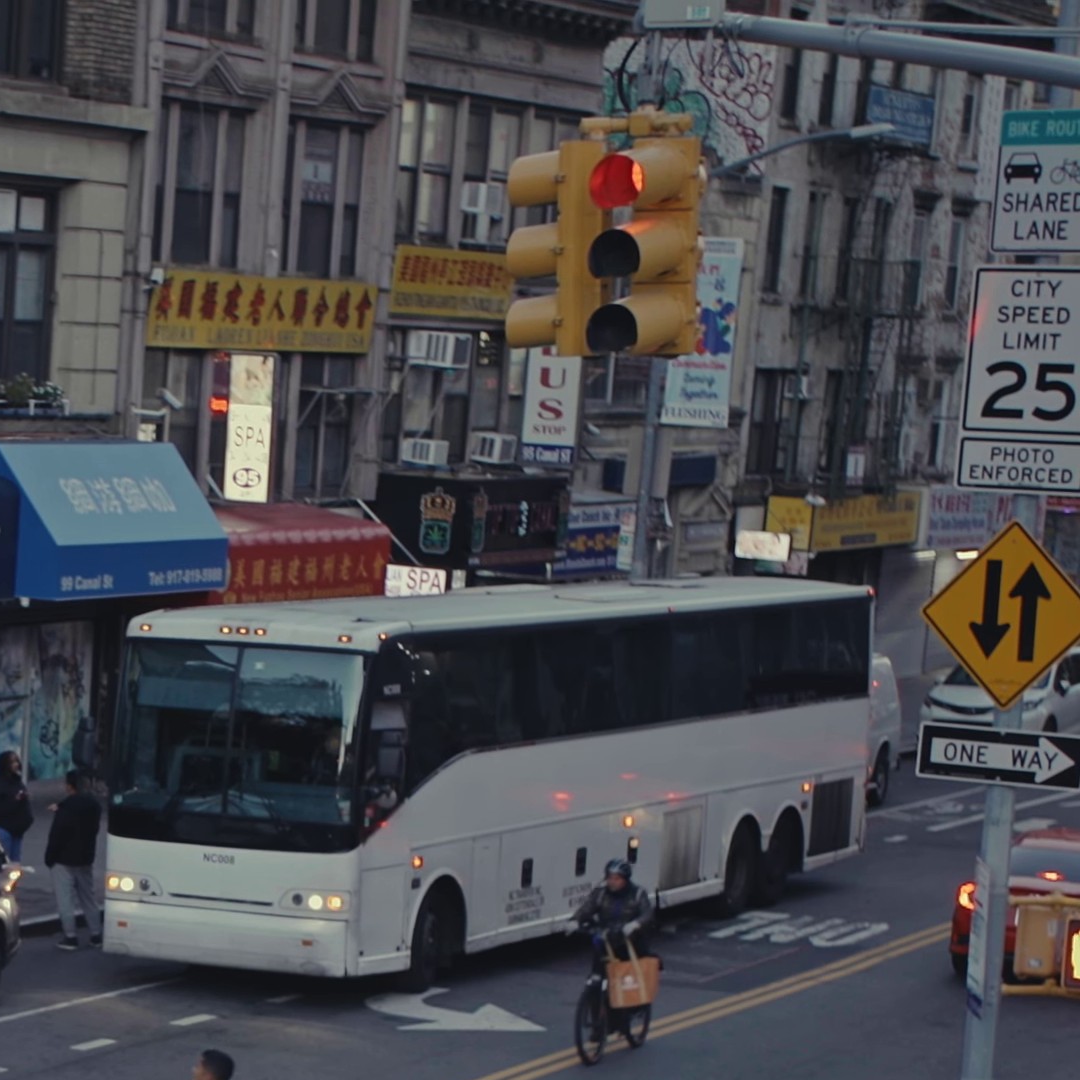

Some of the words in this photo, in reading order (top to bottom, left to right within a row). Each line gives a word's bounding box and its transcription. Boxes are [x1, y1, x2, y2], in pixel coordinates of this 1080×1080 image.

[1008, 120, 1040, 138] BIKE
[1002, 192, 1080, 212] SHARED
[1014, 220, 1069, 240] LANE
[1011, 279, 1062, 298] CITY
[997, 306, 1070, 324] SPEED
[1003, 332, 1062, 350] LIMIT
[981, 361, 1076, 421] 25
[234, 425, 266, 449] SPA
[990, 446, 1054, 464] PHOTO
[969, 465, 1073, 484] ENFORCED
[406, 568, 443, 594] SPA
[943, 742, 989, 765] ONE
[1011, 748, 1059, 770] WAY
